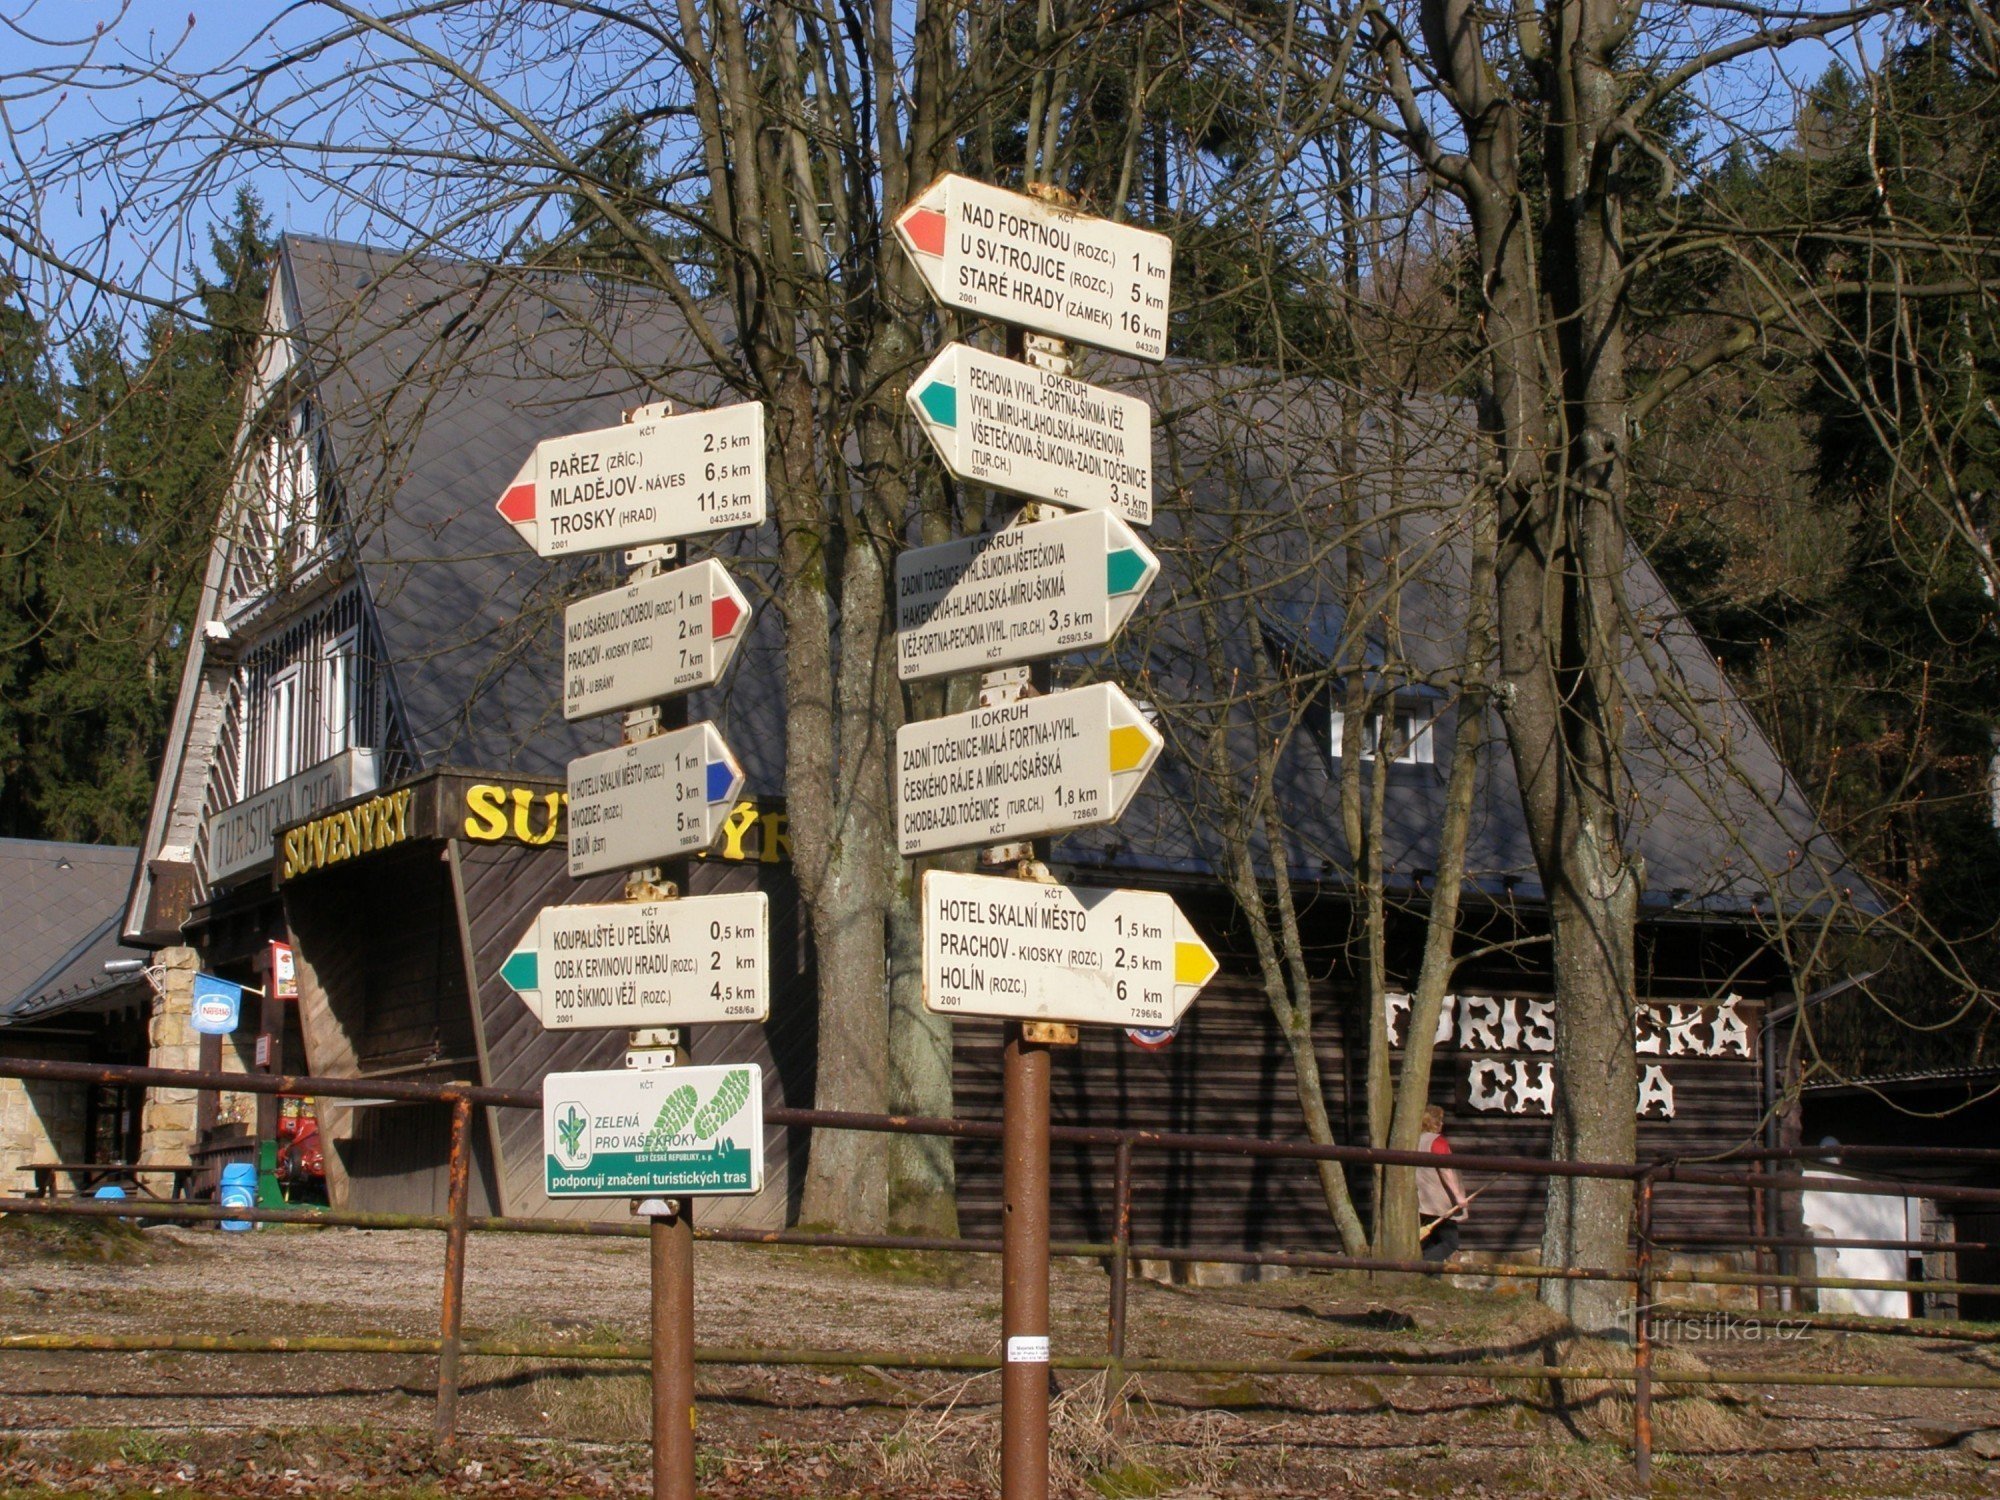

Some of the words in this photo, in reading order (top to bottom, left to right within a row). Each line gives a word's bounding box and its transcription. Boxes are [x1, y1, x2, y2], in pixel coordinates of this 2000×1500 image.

[962, 202, 994, 229] NAD
[998, 214, 1070, 251] FORTNOU
[1074, 241, 1116, 268] (ROZC.)
[1132, 253, 1141, 272] 1
[1147, 263, 1166, 280] km
[960, 234, 972, 254] U
[976, 240, 1065, 282] SV.TROJICE
[1070, 271, 1114, 298] (ROZC.)
[1131, 284, 1141, 302] 5
[1146, 293, 1164, 309] km
[959, 293, 977, 304] 2001
[959, 266, 1008, 297] STARÉ
[1013, 281, 1065, 312] HRADY
[1066, 301, 1113, 329] (ZÁMEK)
[1120, 311, 1141, 333] 16
[1144, 323, 1161, 340] km
[1136, 341, 1160, 354] 0432/0
[1040, 372, 1088, 398] I.OKRUH
[970, 367, 1012, 398] PECHOVA
[1109, 404, 1124, 431] VĚŽ
[640, 426, 656, 437] KČT
[550, 453, 600, 479] PAŘEZ
[606, 451, 643, 473] (ZŘÍC.)
[704, 434, 727, 453] 2,5
[731, 433, 750, 447] km
[971, 449, 1011, 475] (TUR.CH.)
[1133, 494, 1148, 511] km
[972, 466, 988, 477] 2001
[550, 476, 637, 507] MLADĚJOV
[646, 473, 685, 491] NÁVES
[705, 463, 727, 482] 6,5
[732, 462, 750, 477] km
[1054, 487, 1069, 498] KČT
[551, 508, 616, 535] TROSKY
[619, 508, 657, 528] (HRAD)
[698, 492, 728, 512] 11,5
[732, 494, 751, 508] km
[710, 511, 752, 524] 0433/24,5a
[551, 540, 568, 549] 2001
[971, 531, 1024, 554] I.OKRUH
[902, 568, 923, 596] ZADNÍ
[568, 624, 582, 643] NAD
[583, 612, 619, 638] CÍSAŘSKOU
[621, 602, 652, 627] CHODBOU
[679, 591, 684, 609] 1
[690, 593, 702, 605] km
[1010, 621, 1045, 643] (TUR.CH.)
[1049, 610, 1071, 631] 3,5
[1074, 611, 1093, 626] km
[568, 646, 601, 671] PRACHOV
[605, 641, 630, 661] KIOSKY
[679, 621, 686, 639] 2
[690, 623, 702, 635] km
[1057, 631, 1093, 645] 4259/3,5a
[987, 647, 1002, 658] KČT
[568, 674, 584, 700] JIČÍN
[594, 675, 614, 692] BRÁNY
[680, 650, 686, 669] 7
[690, 653, 703, 665] km
[904, 664, 920, 674] 2001
[971, 705, 1029, 729] II.OKRUH
[904, 745, 930, 771] ZADNÍ
[932, 730, 1007, 763] TOČENICE-MALÁ
[1010, 717, 1080, 749] FORTNA-VYHL.
[576, 776, 599, 798] HOTELU
[600, 766, 621, 792] SKALNÍ
[622, 763, 642, 787] MĚSTO
[644, 763, 665, 784] (ROZC.)
[675, 753, 680, 771] 1
[686, 756, 698, 769] km
[904, 773, 947, 802] ČESKÉHO
[950, 773, 974, 794] RÁJE
[977, 773, 983, 788] A
[986, 749, 1062, 786] MÍRU-CÍSAŘSKÁ
[571, 804, 601, 829] HVOZDEC
[676, 783, 683, 801] 3
[686, 787, 698, 799] km
[1007, 796, 1044, 819] (TUR.CH.)
[1055, 786, 1075, 808] 1,8
[1079, 787, 1097, 802] km
[1073, 808, 1098, 820] 7286/0
[677, 812, 684, 832] 5
[687, 817, 700, 829] km
[990, 823, 1006, 834] KČT
[906, 839, 921, 850] 2001
[1044, 889, 1063, 900] KČT
[642, 908, 658, 917] KČT
[940, 899, 985, 924] HOTEL
[989, 902, 1037, 928] SKALNÍ
[1042, 904, 1086, 932] MĚSTO
[1114, 916, 1138, 938] 1,5
[1143, 923, 1162, 939] km
[553, 923, 615, 950] KOUPALIŠTĚ
[618, 928, 624, 945] U
[628, 921, 671, 945] PELÍŠKA
[710, 921, 732, 941] 0,5
[736, 925, 754, 938] km
[586, 957, 632, 977] ERVINOVU
[635, 954, 668, 974] HRADU
[671, 957, 698, 975] (ROZC.)
[711, 952, 721, 970] 2
[736, 956, 755, 969] km
[940, 934, 1008, 959] PRACHOV
[1019, 943, 1063, 964] KIOSKY
[1068, 949, 1103, 969] (ROZC.)
[1115, 948, 1138, 971] 2,5
[1143, 956, 1162, 971] km
[555, 990, 574, 1008] POD
[577, 985, 612, 1008] ŠIKMOU
[615, 982, 636, 1005] VĚŽÍ
[641, 990, 671, 1007] (ROZC.)
[710, 981, 732, 1001] 4,5
[736, 986, 755, 999] km
[941, 967, 984, 991] HOLÍN
[989, 977, 1027, 998] (ROZC.)
[1117, 981, 1127, 1001] 6
[1144, 988, 1162, 1003] km
[725, 1005, 755, 1015] 4258/6a
[941, 996, 961, 1005] 2001
[557, 1014, 573, 1023] 2001
[1131, 1009, 1162, 1019] 7296/6a
[640, 1081, 654, 1089] KČT
[1468, 1058, 1676, 1118] CHA
[594, 1112, 639, 1128] ZELENÁ
[595, 1137, 619, 1149] PRO
[623, 1133, 650, 1148] VAŠE
[655, 1134, 698, 1146] KROKY
[635, 1154, 649, 1162] LESY
[650, 1152, 667, 1161] ČESKÉ
[668, 1153, 701, 1161] REPUBLIKY,
[553, 1172, 605, 1188] podporují
[607, 1172, 650, 1186] značení
[653, 1171, 719, 1189] turistických
[724, 1172, 746, 1183] tras
